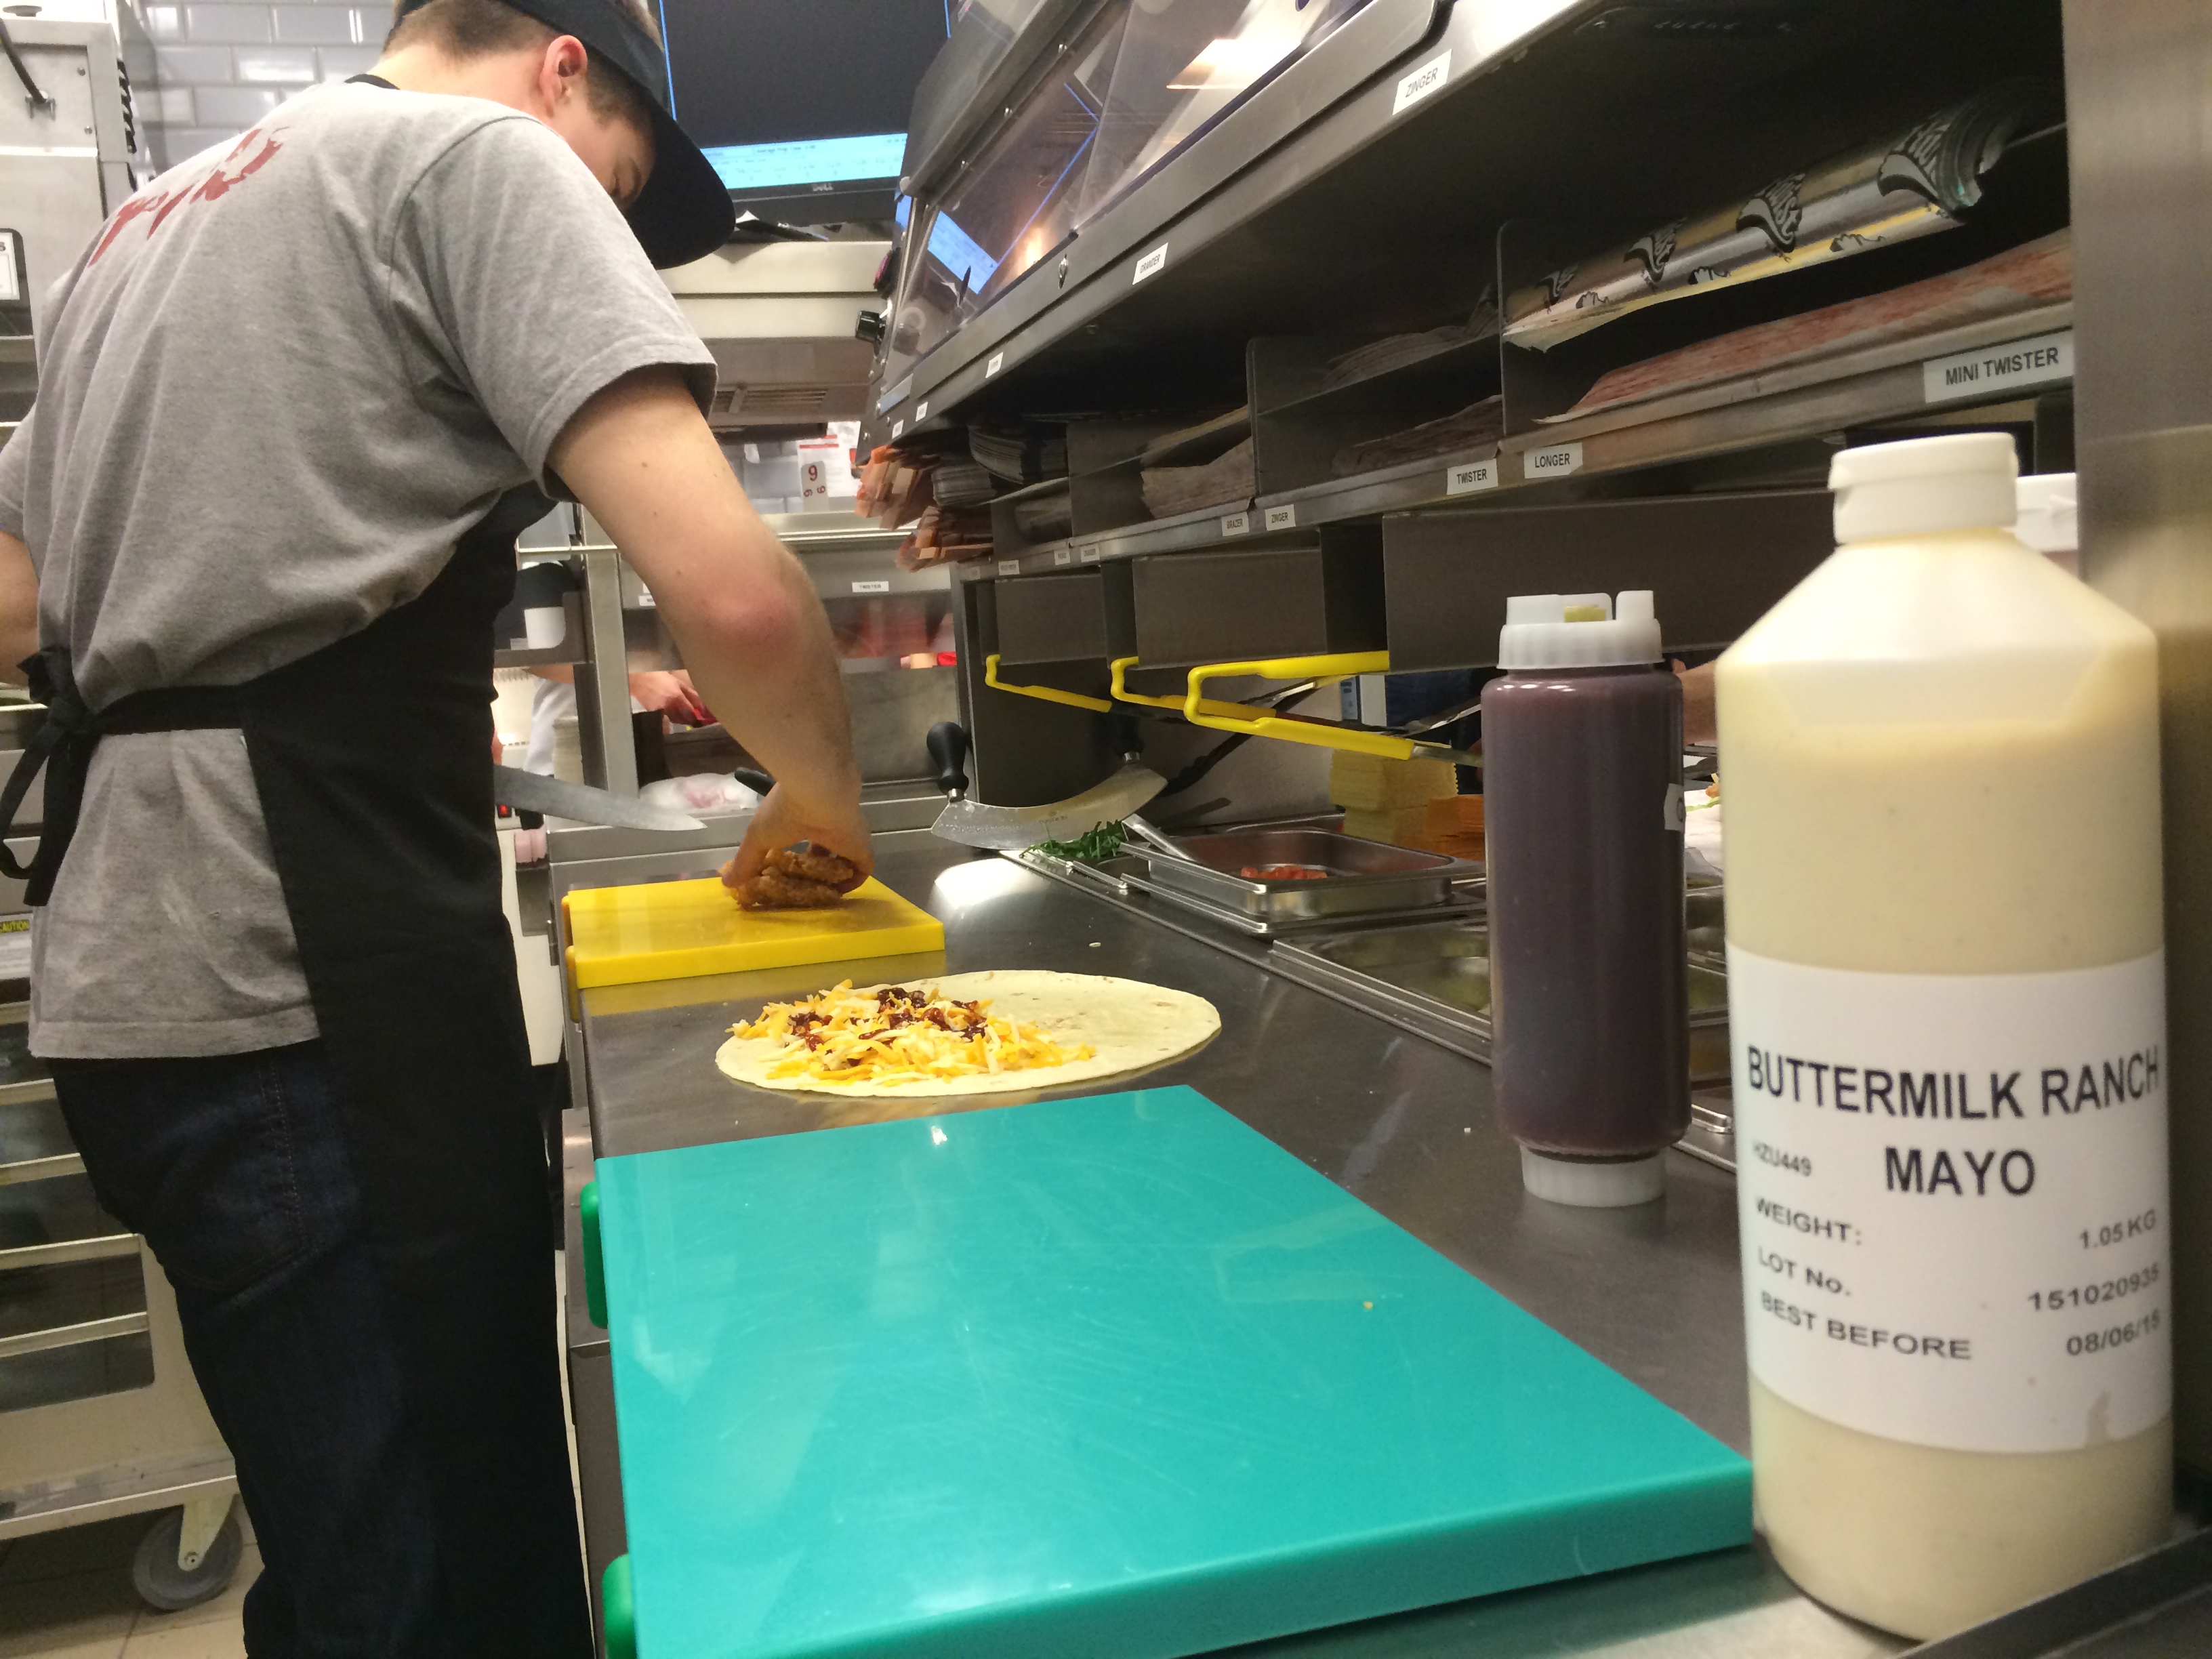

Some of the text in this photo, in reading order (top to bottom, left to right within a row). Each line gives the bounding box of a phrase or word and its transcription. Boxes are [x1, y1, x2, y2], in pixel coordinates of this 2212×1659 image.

[1405, 67, 1438, 98] ZINGER
[1946, 346, 2060, 386] MINI TWISTER
[808, 464, 818, 481] 9
[1456, 468, 1488, 485] TWISTER
[1535, 453, 1570, 468] LONGER
[1271, 512, 1289, 524] ZINGER
[1748, 1044, 2158, 1120] BUTTERMILK RANCH
[1885, 1145, 2035, 1197] MAYO
[1756, 1197, 1862, 1246] WEIGHT:
[2078, 1208, 2155, 1250] 1.05 KG
[1759, 1246, 1797, 1279] LOT
[1762, 1290, 1970, 1360] BEST BEFORE
